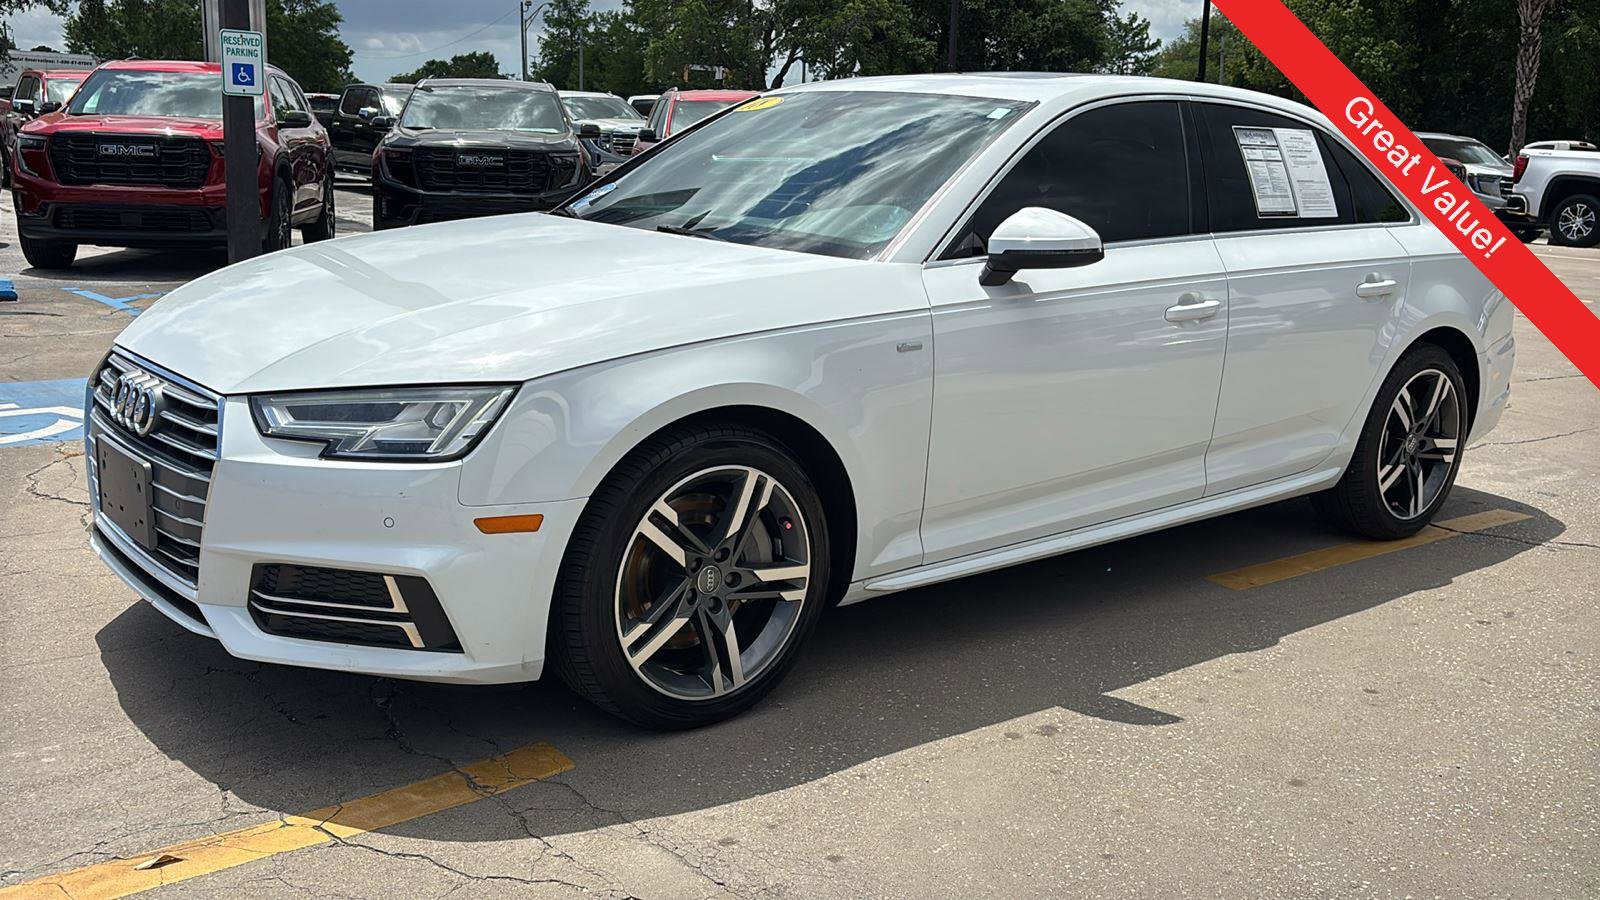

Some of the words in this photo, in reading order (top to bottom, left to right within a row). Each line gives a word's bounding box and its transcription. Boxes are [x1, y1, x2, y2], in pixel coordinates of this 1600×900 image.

[223, 36, 260, 47] RESERVED
[226, 47, 258, 58] PARKING
[100, 144, 154, 157] GMC
[458, 155, 504, 166] GMC
